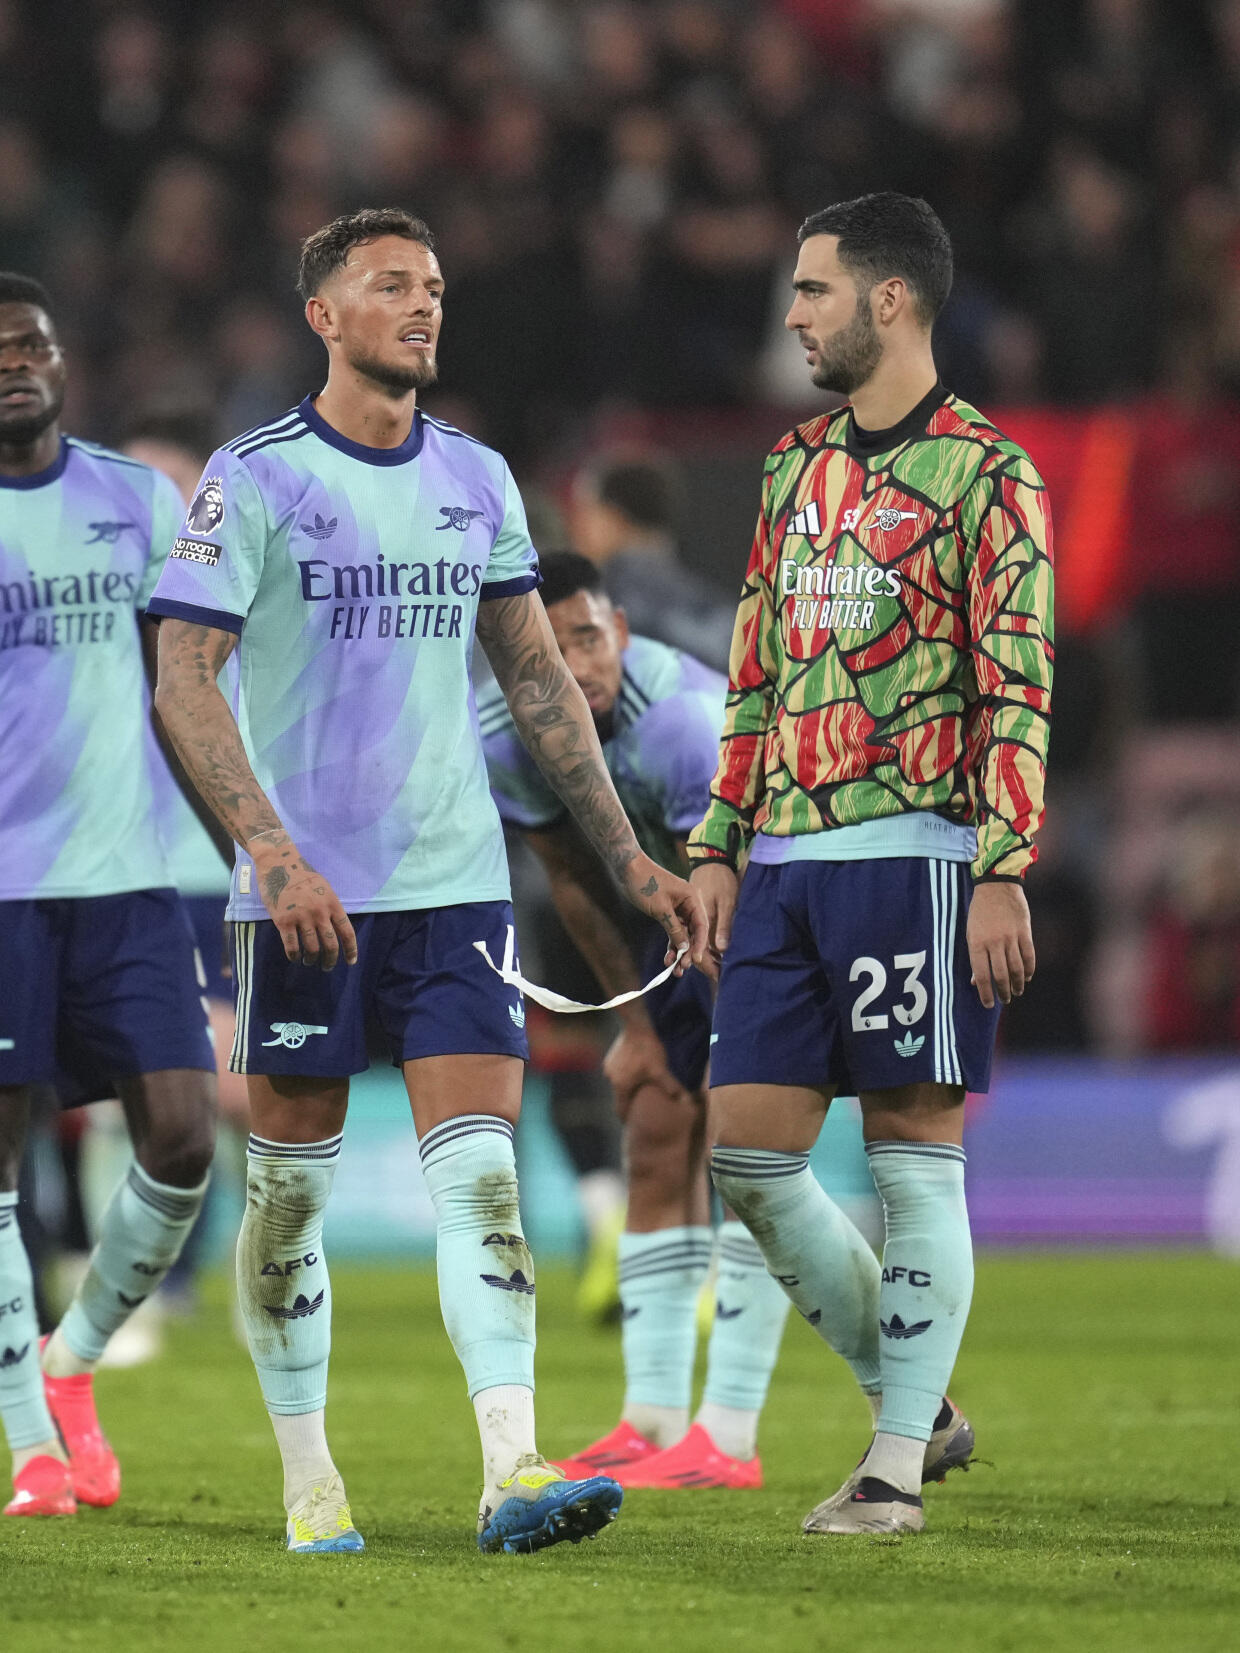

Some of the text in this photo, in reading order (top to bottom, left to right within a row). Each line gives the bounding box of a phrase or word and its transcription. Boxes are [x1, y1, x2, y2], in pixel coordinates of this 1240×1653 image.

[173, 538, 216, 556] No room
[182, 549, 218, 567] racism
[298, 553, 482, 601] Emirates
[781, 558, 902, 597] Emirates
[34, 611, 115, 646] BETTER
[329, 604, 462, 639] FLY BETTER
[791, 600, 875, 630] FLY BETTER
[848, 950, 929, 1032] 23
[260, 1252, 318, 1277] AFC
[881, 1266, 932, 1288] AFC
